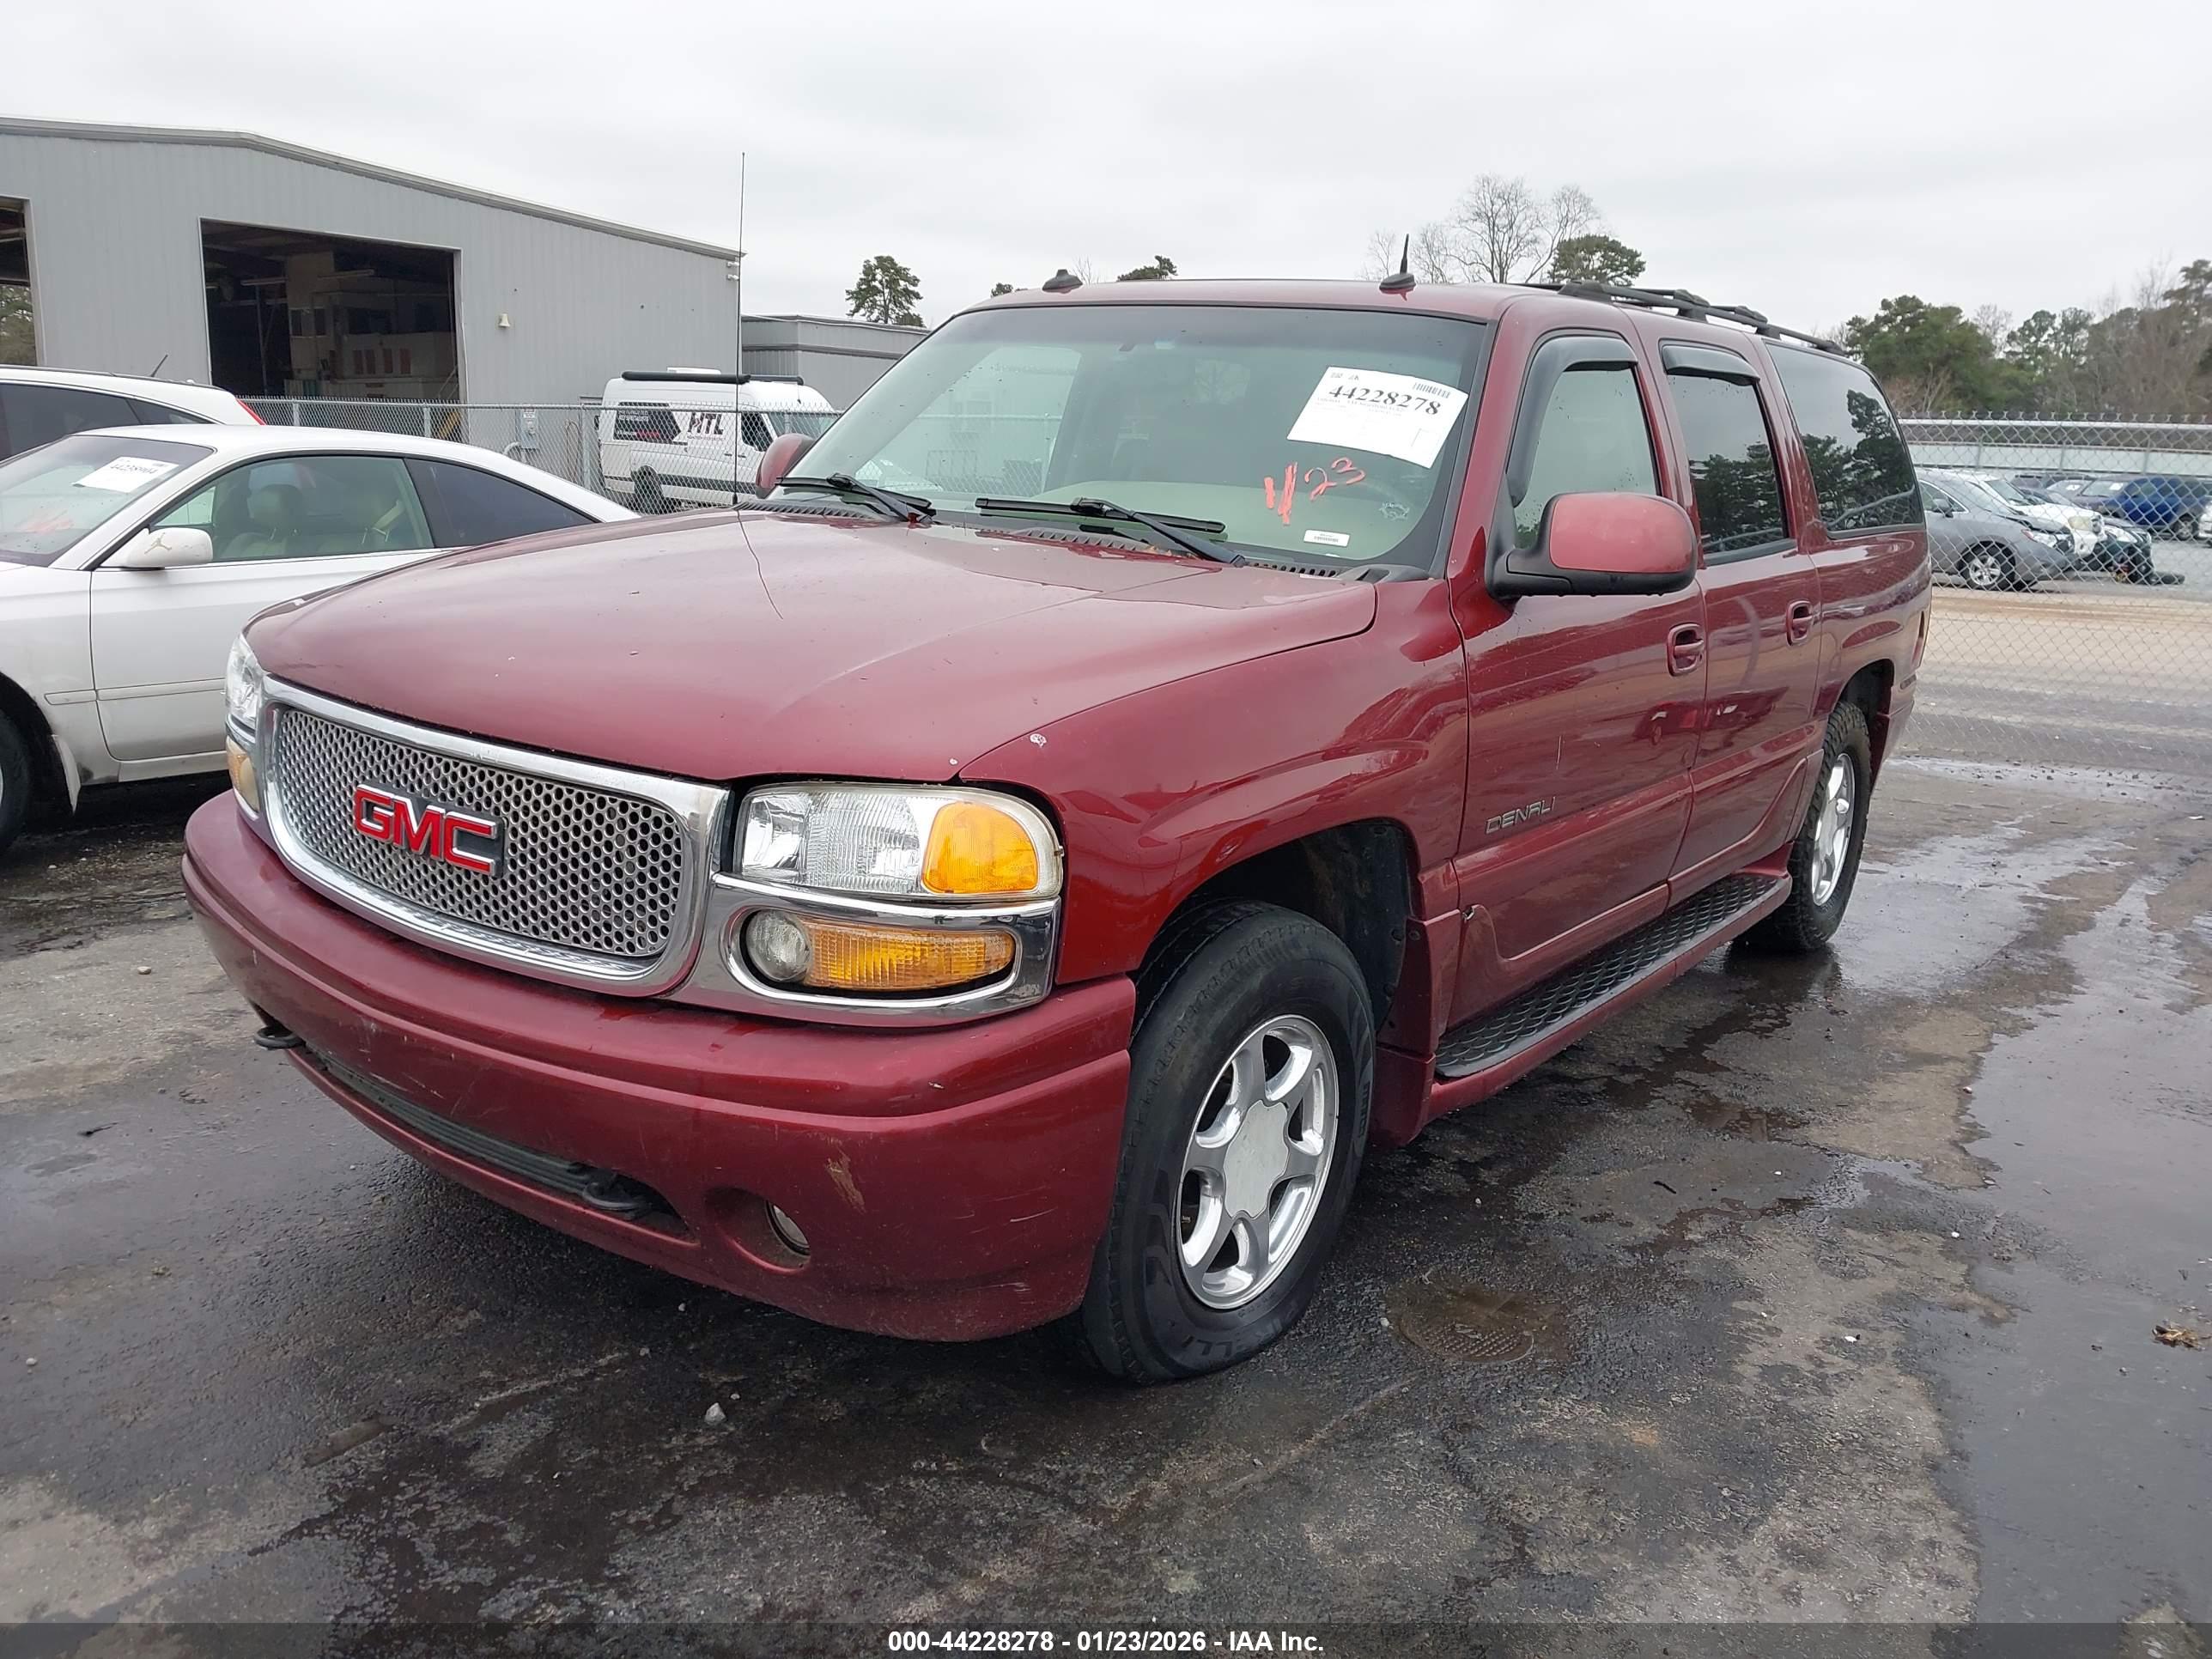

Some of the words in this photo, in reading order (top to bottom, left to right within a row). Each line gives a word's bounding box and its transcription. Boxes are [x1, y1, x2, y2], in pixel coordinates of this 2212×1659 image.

[1328, 385, 1442, 416] 44228278
[354, 783, 497, 877] GMC
[1486, 796, 1556, 835] DENALI
